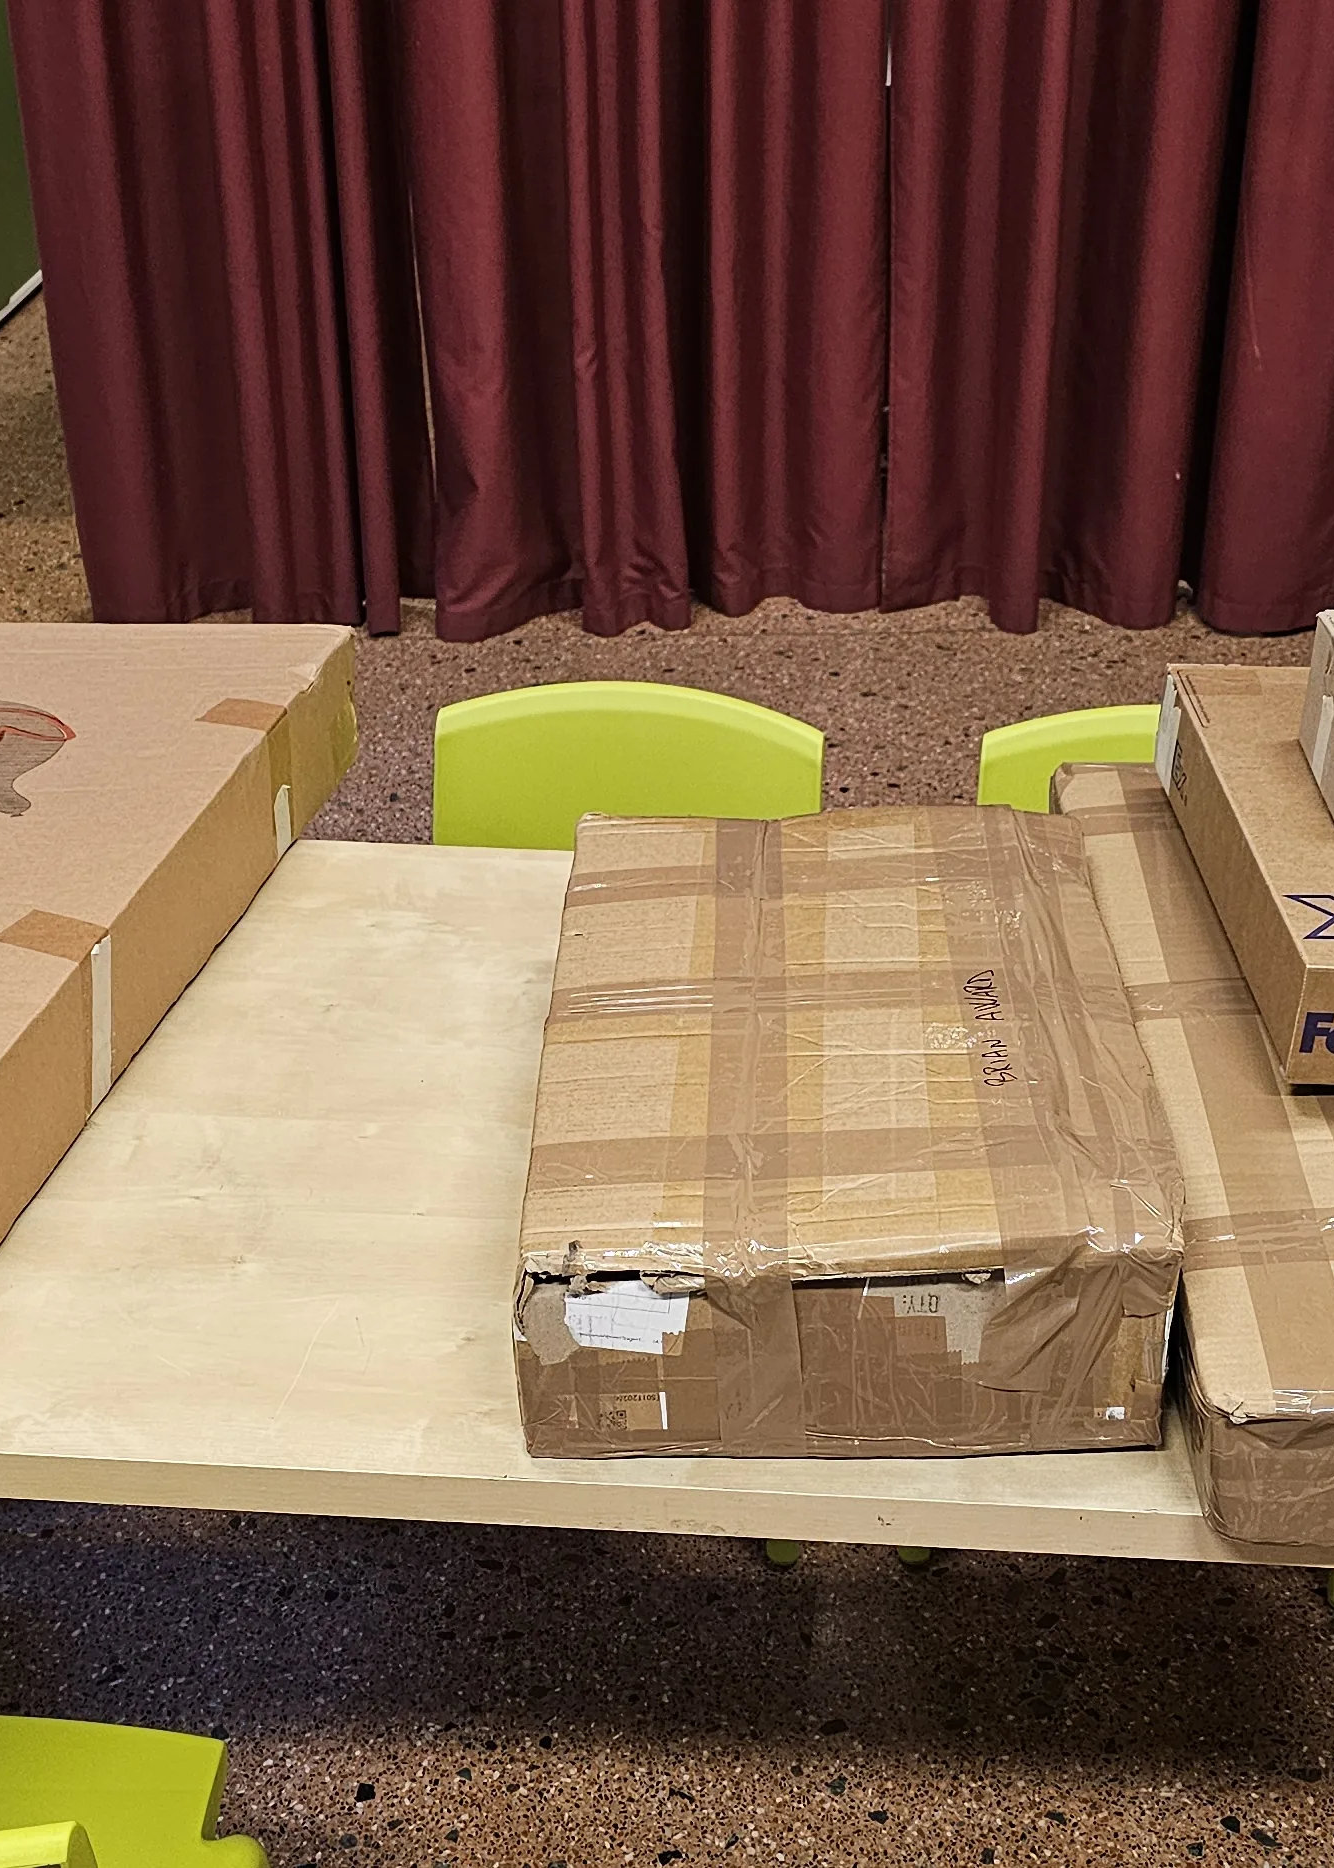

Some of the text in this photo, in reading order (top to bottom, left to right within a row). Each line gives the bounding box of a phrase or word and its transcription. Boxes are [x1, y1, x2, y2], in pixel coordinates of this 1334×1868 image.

[963, 969, 1018, 1087] BRIAN AWARD
[903, 1292, 939, 1314] QTY:
